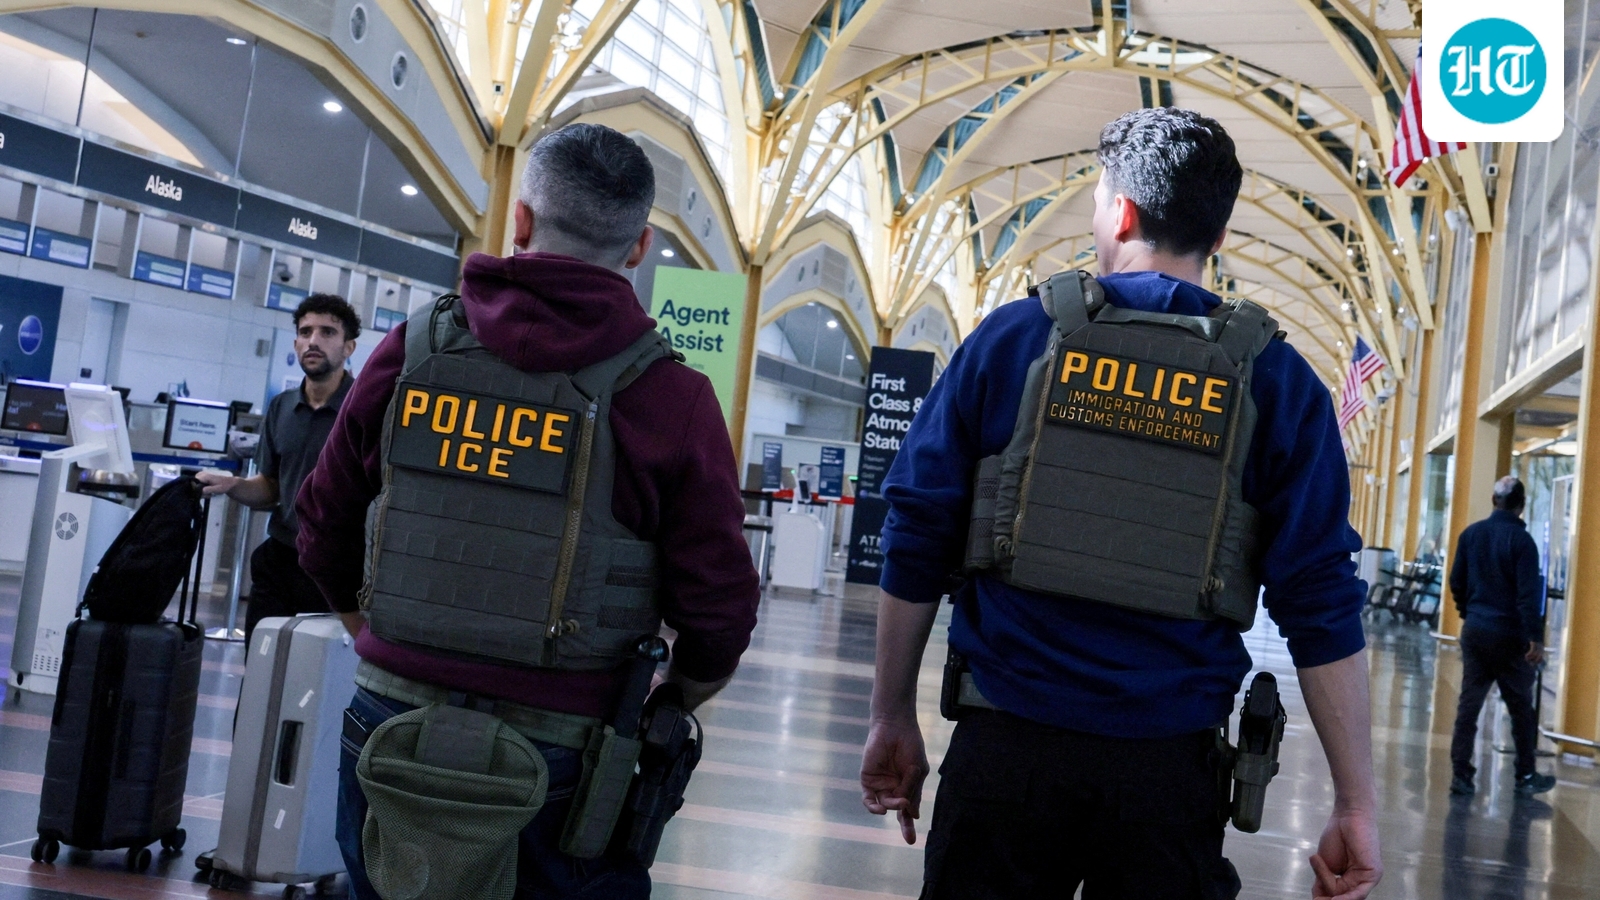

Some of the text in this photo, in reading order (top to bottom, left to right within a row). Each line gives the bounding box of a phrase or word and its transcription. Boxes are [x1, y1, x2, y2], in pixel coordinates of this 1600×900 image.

[145, 174, 183, 202] Alaska
[288, 217, 318, 240] Alaska
[658, 299, 730, 326] Agent
[660, 327, 724, 352] Assist
[871, 373, 906, 392] First
[1060, 350, 1229, 414] POLICE
[868, 393, 910, 412] Class
[1068, 390, 1203, 428] IMMIGRATION AND
[401, 388, 570, 454] POLICE
[866, 413, 912, 432] Atmo
[1050, 403, 1221, 449] CUSTOMS ENFORCEMENT
[864, 432, 904, 451] Statu
[438, 439, 514, 479] ICE
